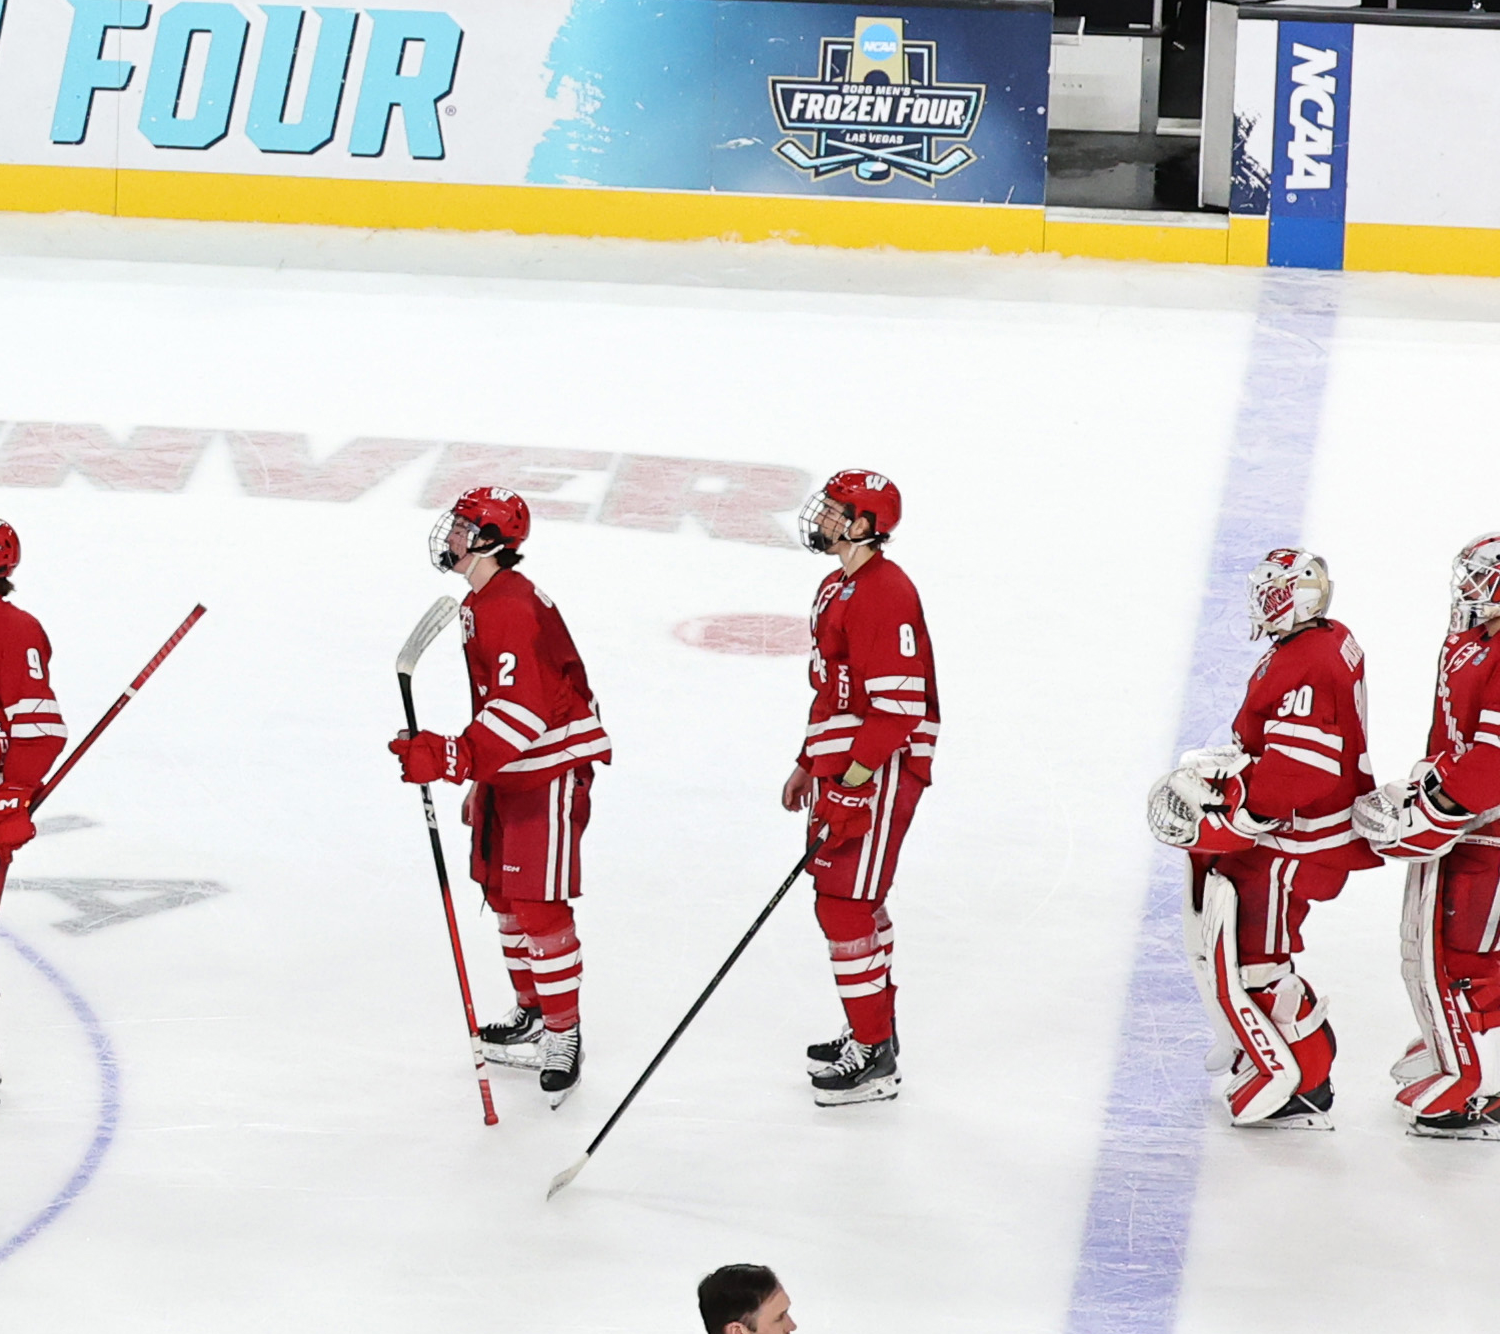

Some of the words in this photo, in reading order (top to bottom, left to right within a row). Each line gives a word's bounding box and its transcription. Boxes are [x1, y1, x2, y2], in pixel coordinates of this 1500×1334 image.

[861, 41, 898, 55] NCAA
[842, 83, 874, 95] 2026
[876, 84, 911, 97] MEN'S
[790, 91, 893, 126] FROZEN
[897, 93, 966, 127] FOUR
[1286, 43, 1339, 190] NCAA
[844, 132, 867, 144] LAS
[870, 132, 905, 146] VEGAS
[865, 474, 889, 491] W
[899, 623, 916, 658] 8
[26, 647, 43, 680] 9
[498, 652, 517, 686] 2
[836, 663, 848, 709] CCM
[1277, 684, 1313, 718] 30
[826, 790, 874, 808] CCM
[1238, 1005, 1282, 1073] CCM
[1443, 987, 1471, 1068] TRUE
